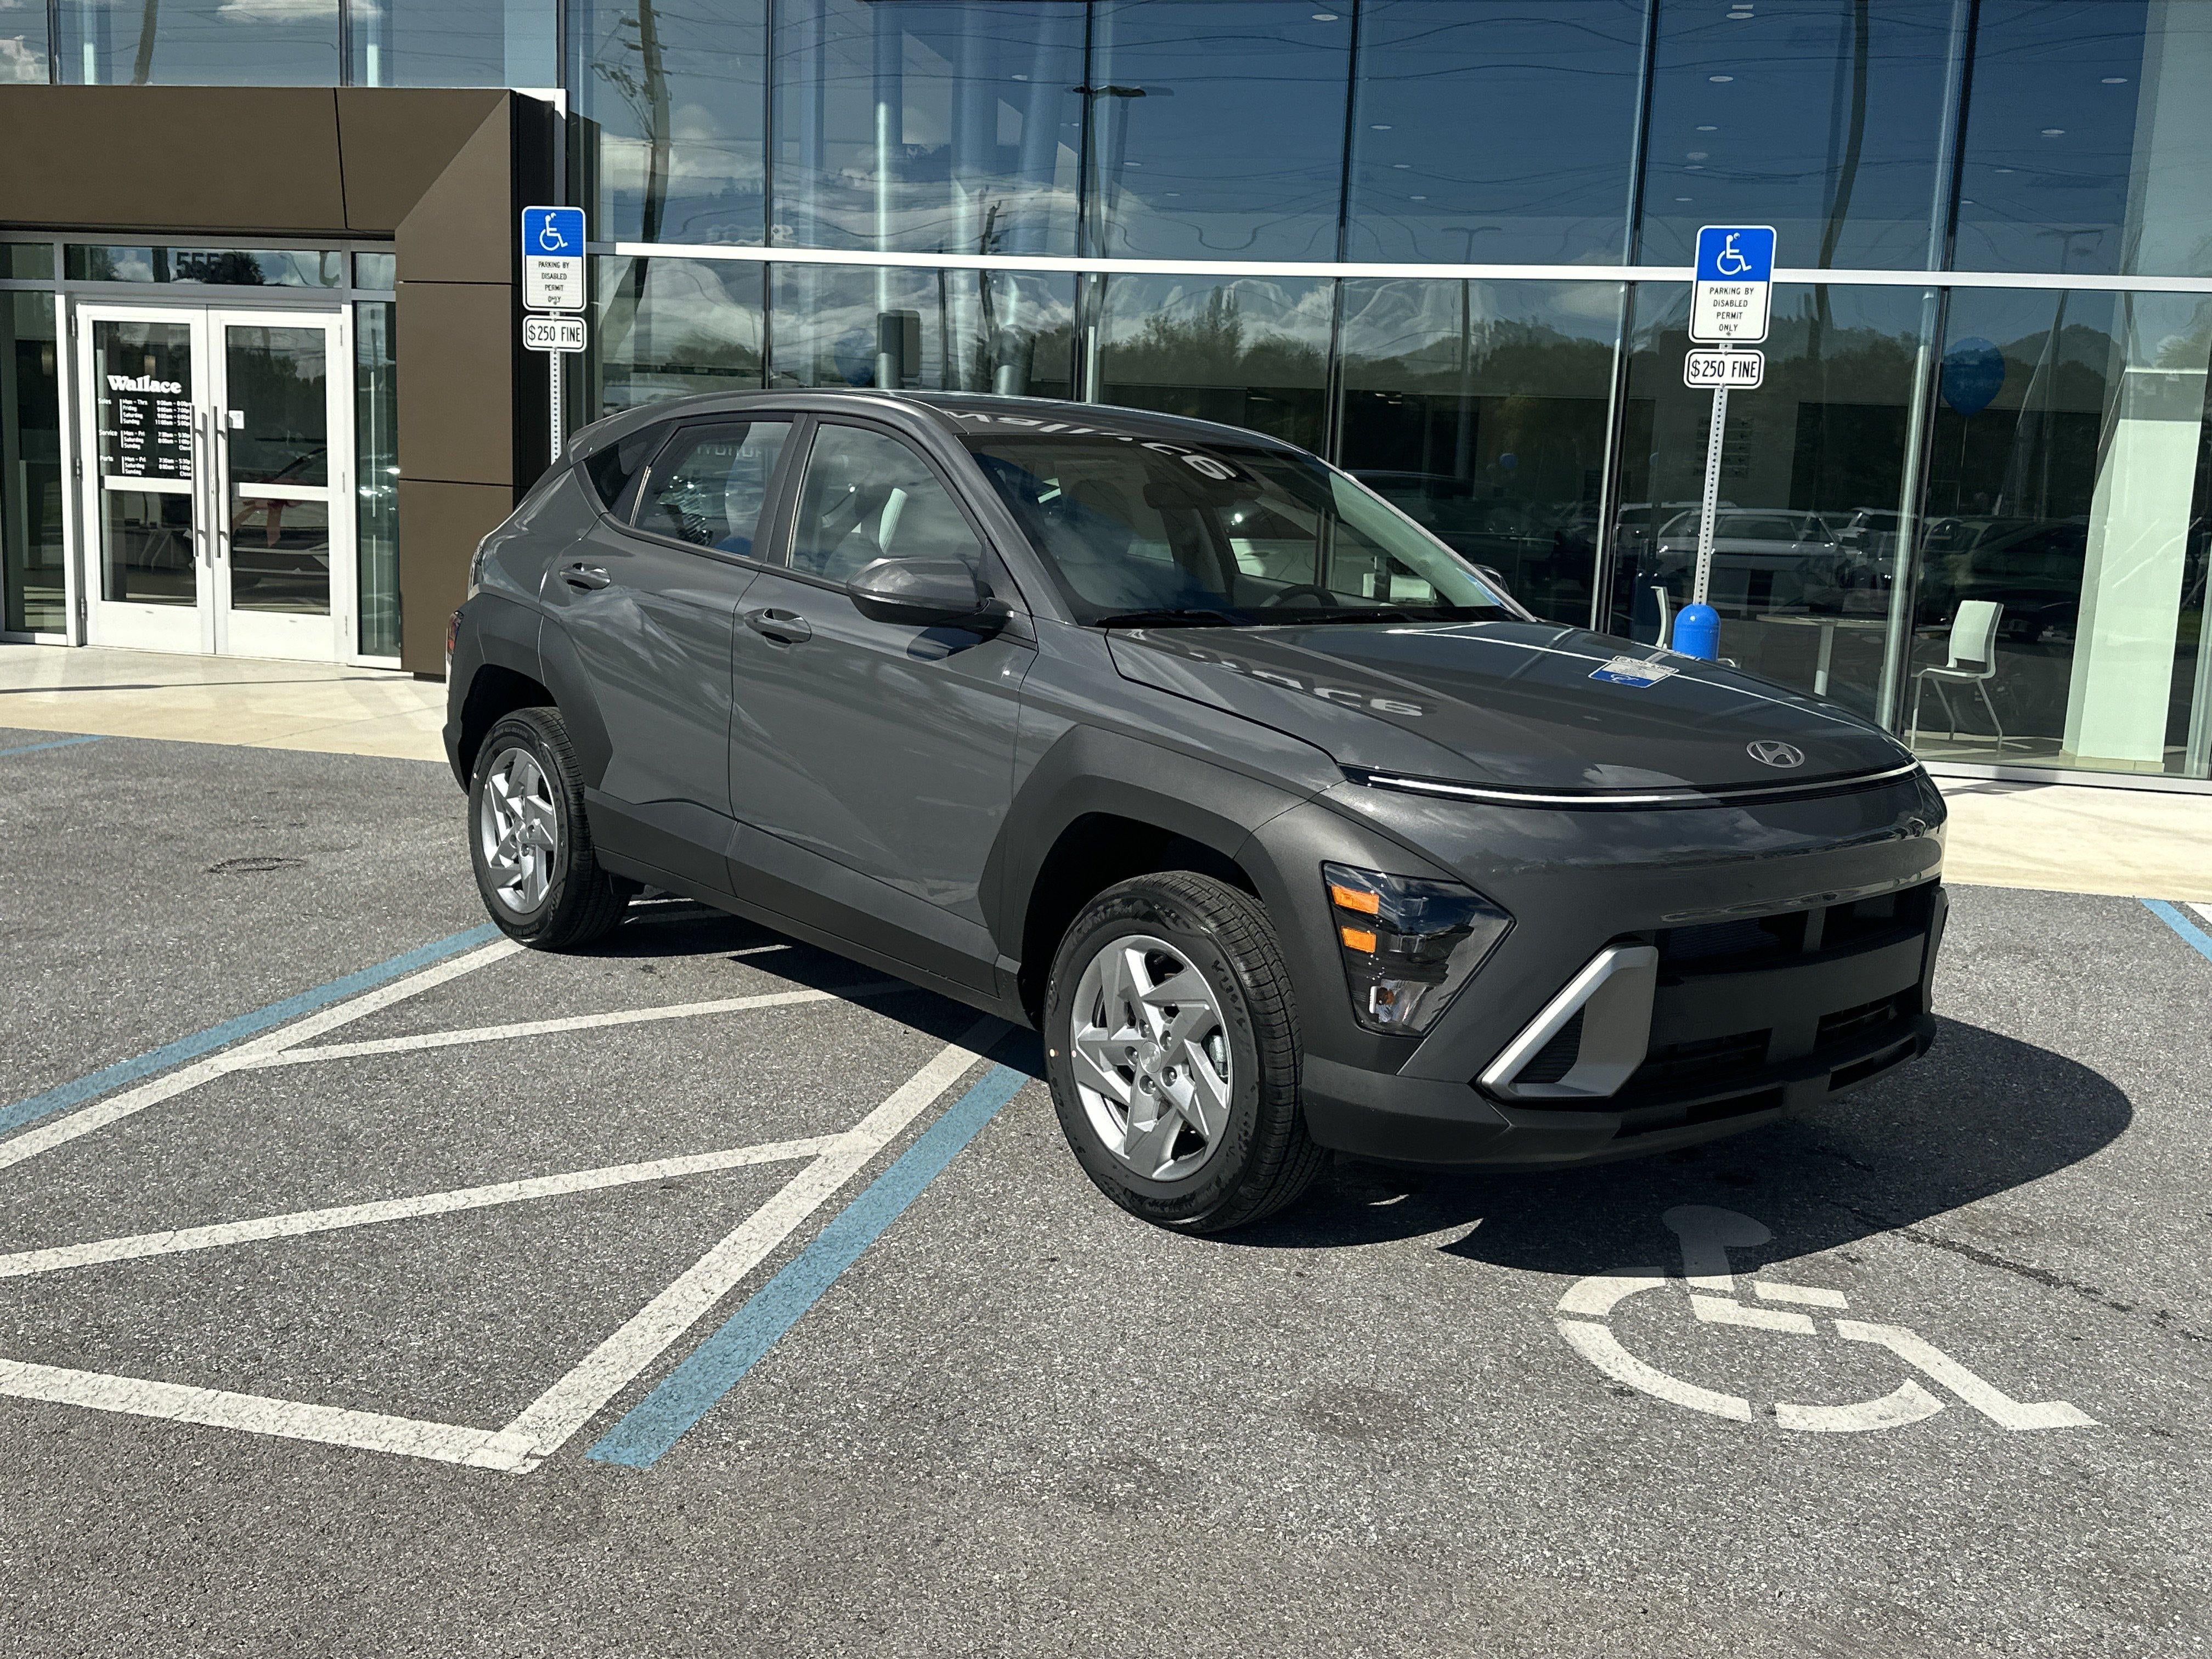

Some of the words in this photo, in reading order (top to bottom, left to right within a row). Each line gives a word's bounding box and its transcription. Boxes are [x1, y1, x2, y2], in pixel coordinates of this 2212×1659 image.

[1709, 287, 1741, 295] PARKING
[1744, 287, 1754, 295] BY
[1713, 299, 1748, 307] DISABLED
[1716, 311, 1743, 319] PERMIT
[528, 324, 556, 342] $250
[561, 326, 581, 342] FINE
[1691, 358, 1725, 379] $250
[1731, 360, 1757, 377] FINE
[106, 375, 182, 394] Wallace
